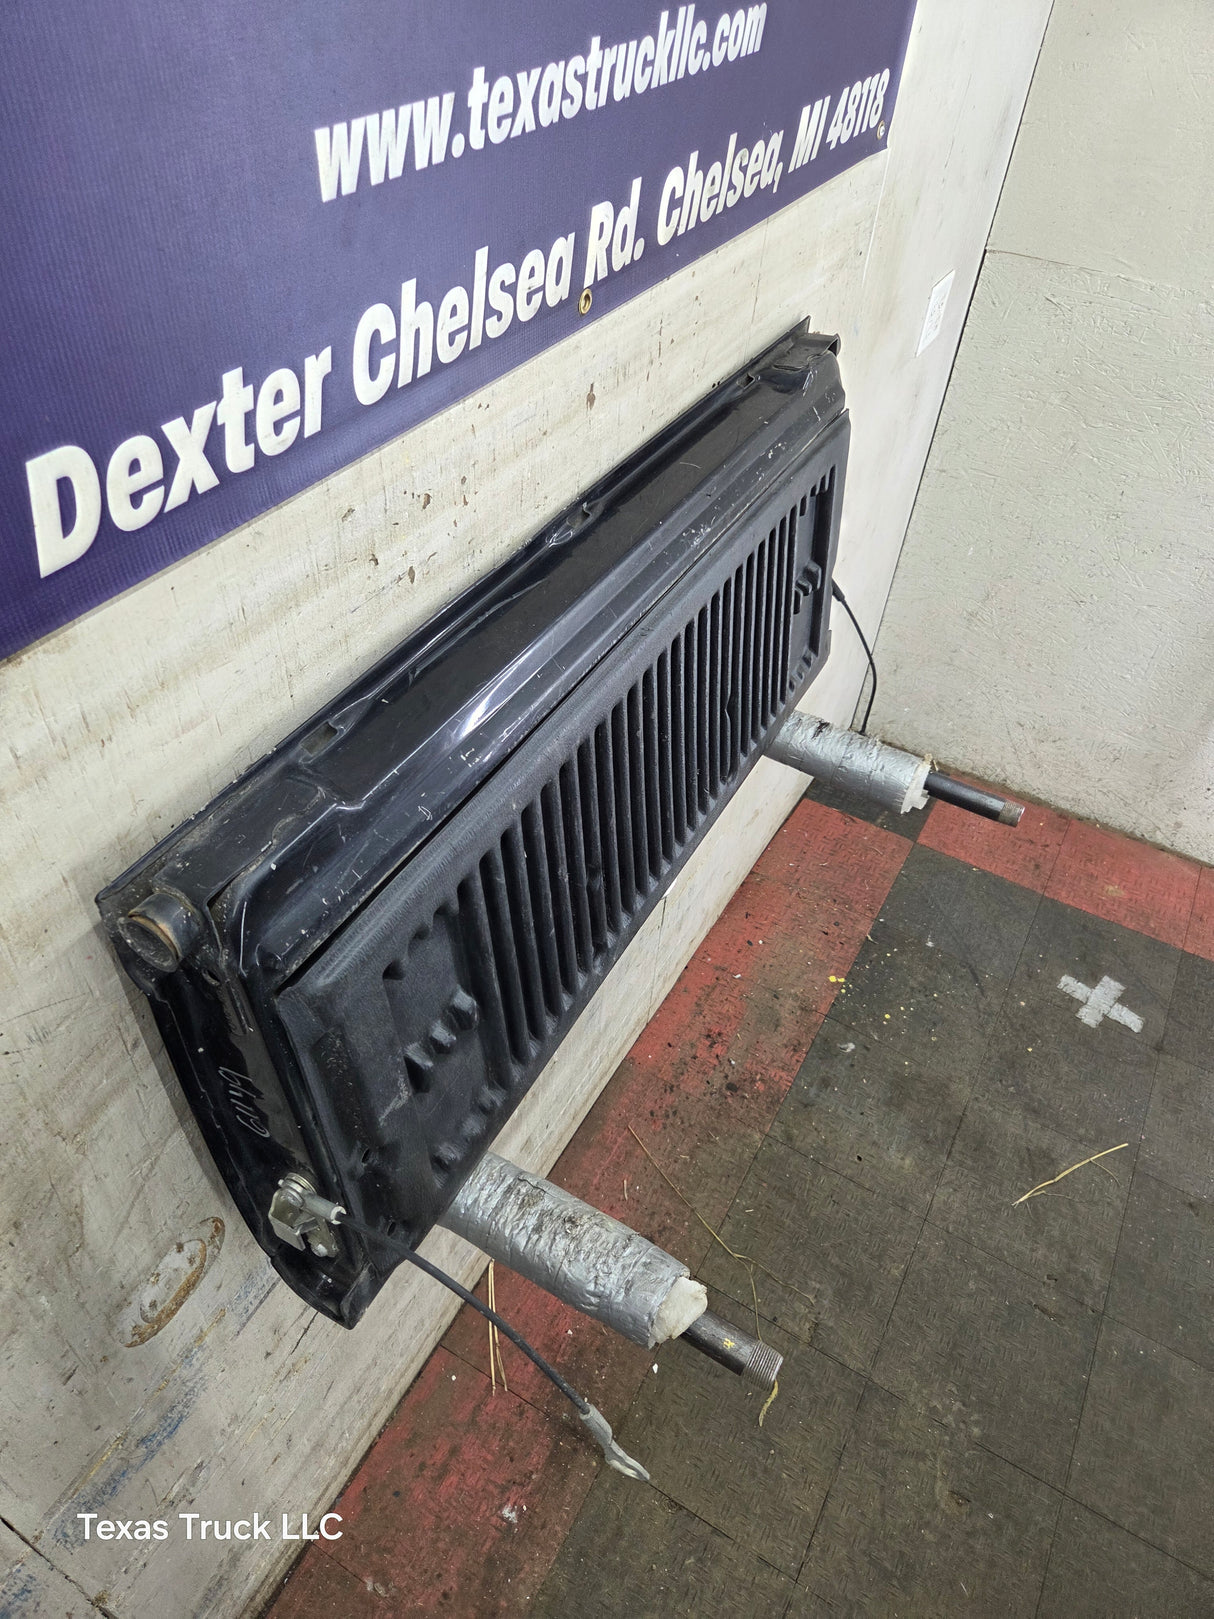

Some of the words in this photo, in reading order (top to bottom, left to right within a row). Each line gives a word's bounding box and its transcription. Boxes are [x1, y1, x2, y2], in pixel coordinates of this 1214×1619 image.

[314, 2, 768, 203] www.texastruckllc.com
[25, 343, 333, 578] Dexter
[353, 231, 576, 406] Chelsea
[583, 177, 645, 289] Rd.
[657, 128, 785, 247] Chelsea,
[788, 95, 831, 174] MI
[825, 67, 891, 151] 48118
